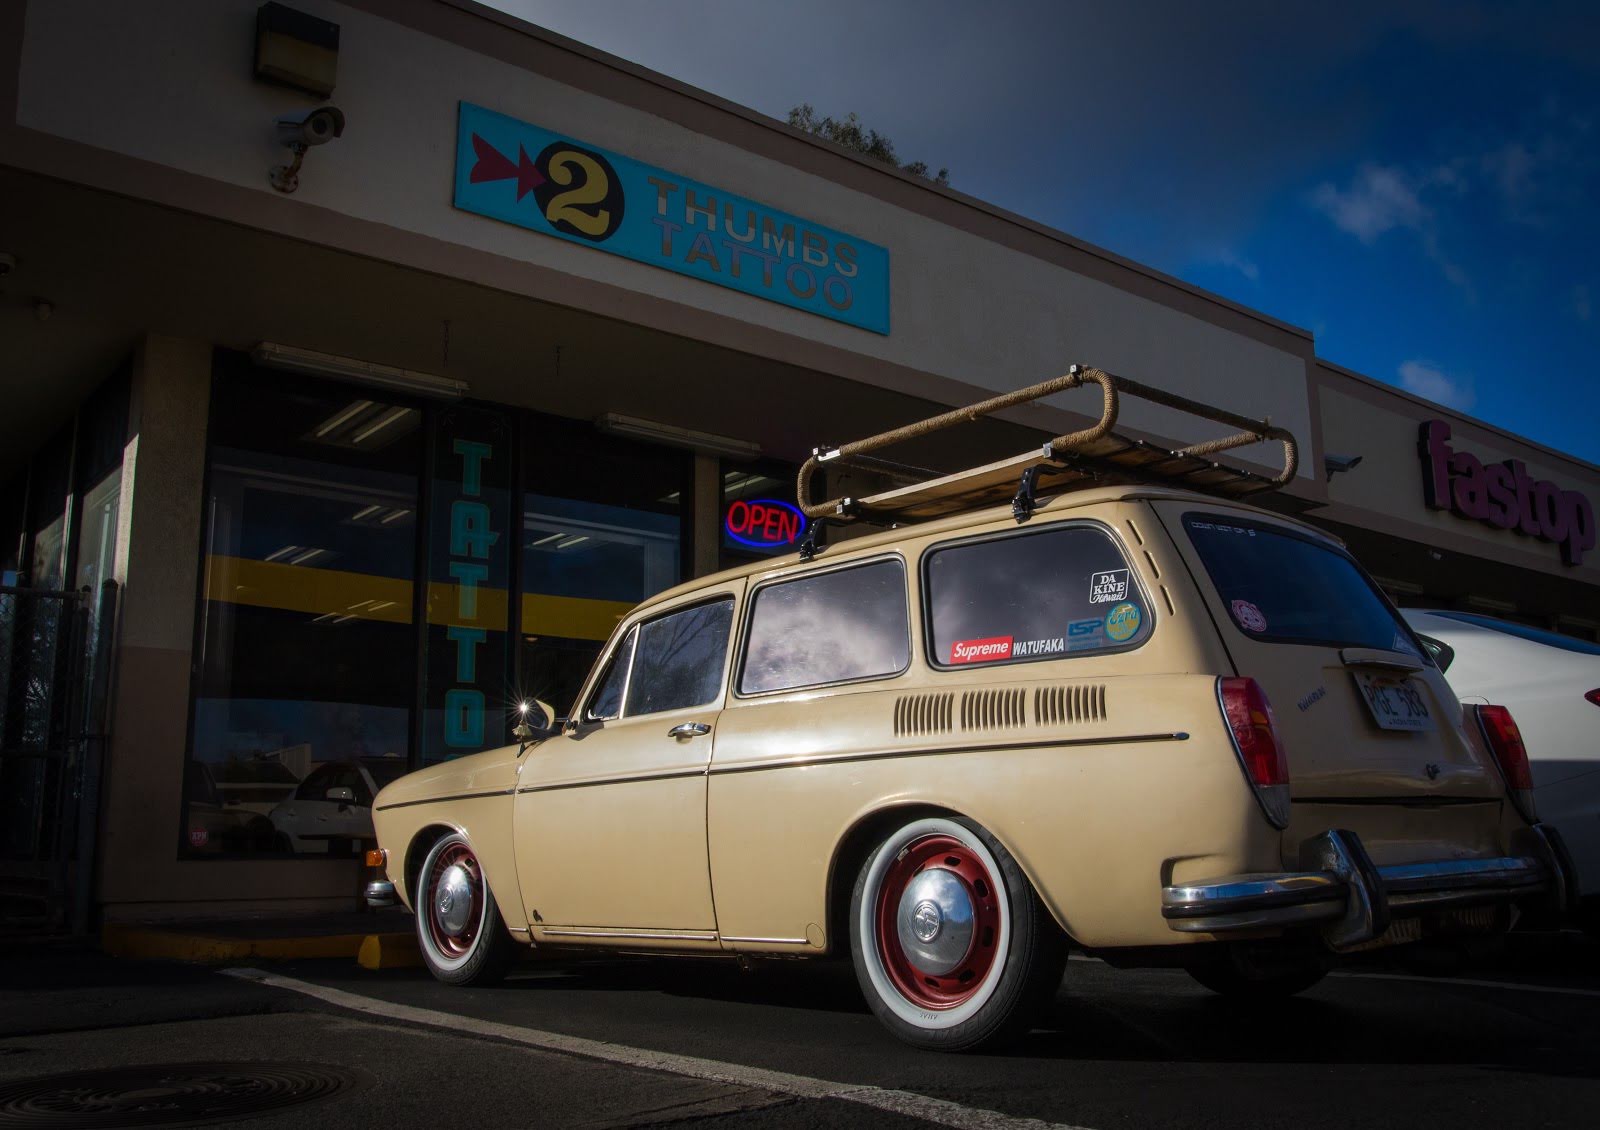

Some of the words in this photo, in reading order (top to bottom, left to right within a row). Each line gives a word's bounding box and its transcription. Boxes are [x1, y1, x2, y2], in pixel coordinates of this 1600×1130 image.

[546, 150, 610, 236] 2
[648, 175, 859, 278] THUMBS
[653, 217, 854, 312] TATTOO
[727, 500, 799, 544] OPEN
[1418, 419, 1596, 567] fastop
[444, 438, 499, 760] TATTO
[1100, 574, 1117, 585] DA
[954, 642, 1009, 660] Supreme
[1013, 638, 1065, 655] WATUFAKA
